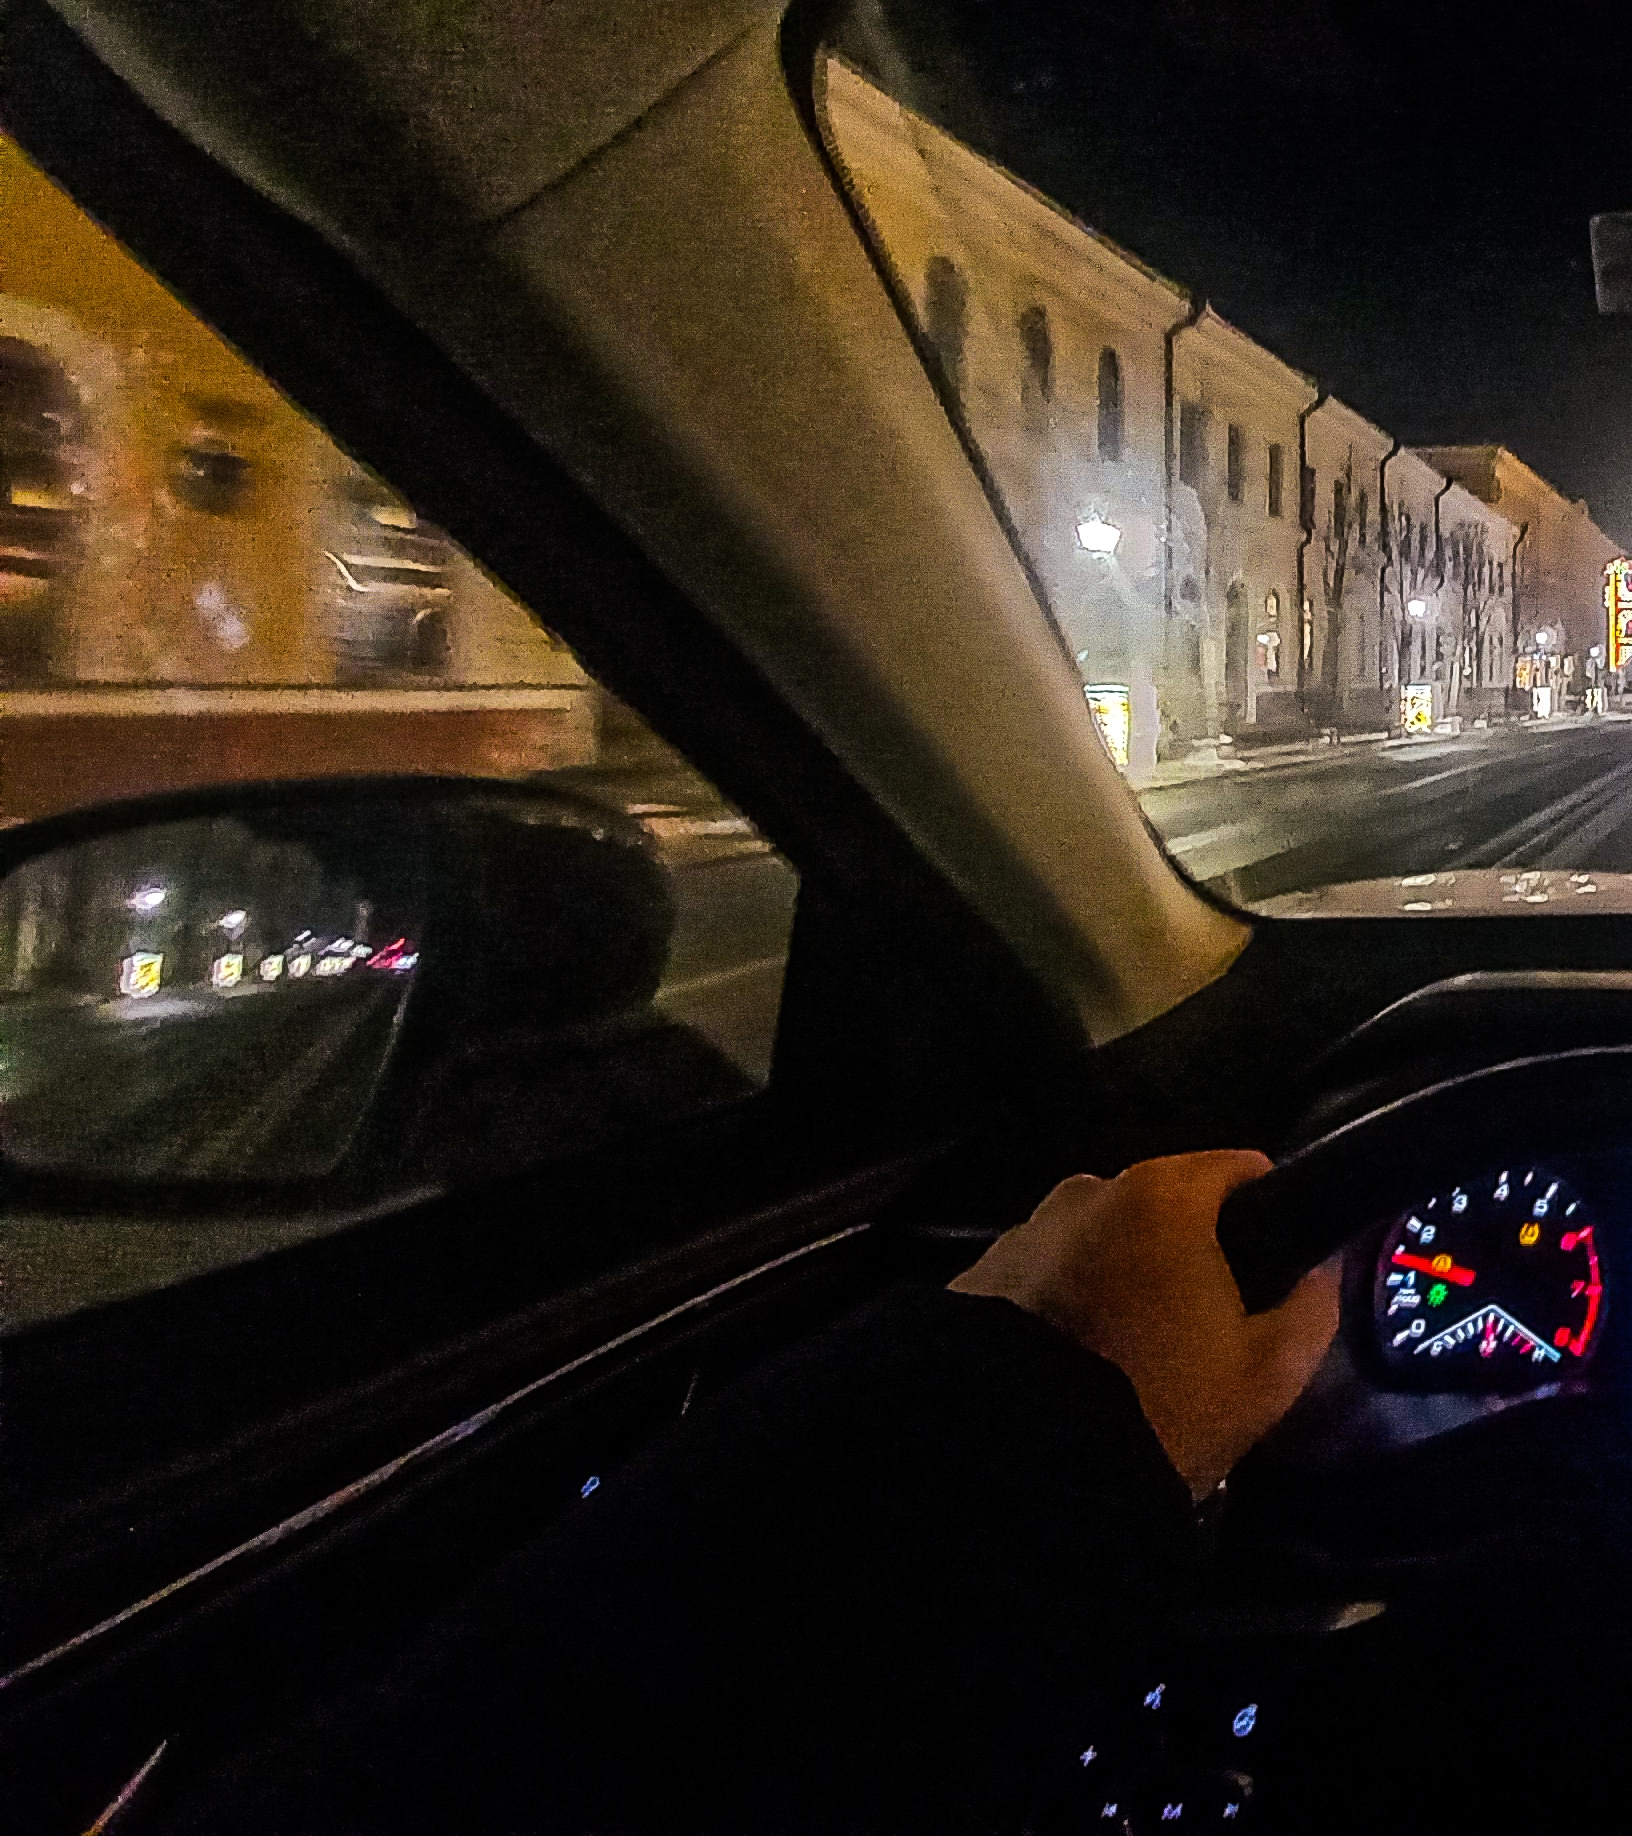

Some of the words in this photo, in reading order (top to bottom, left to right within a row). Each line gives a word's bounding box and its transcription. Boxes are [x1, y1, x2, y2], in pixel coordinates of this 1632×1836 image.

[1493, 1182, 1510, 1201] 4
[1452, 1193, 1469, 1214] 3
[1532, 1198, 1548, 1217] 5
[1419, 1224, 1437, 1244] 2
[1409, 1319, 1426, 1337] 0
